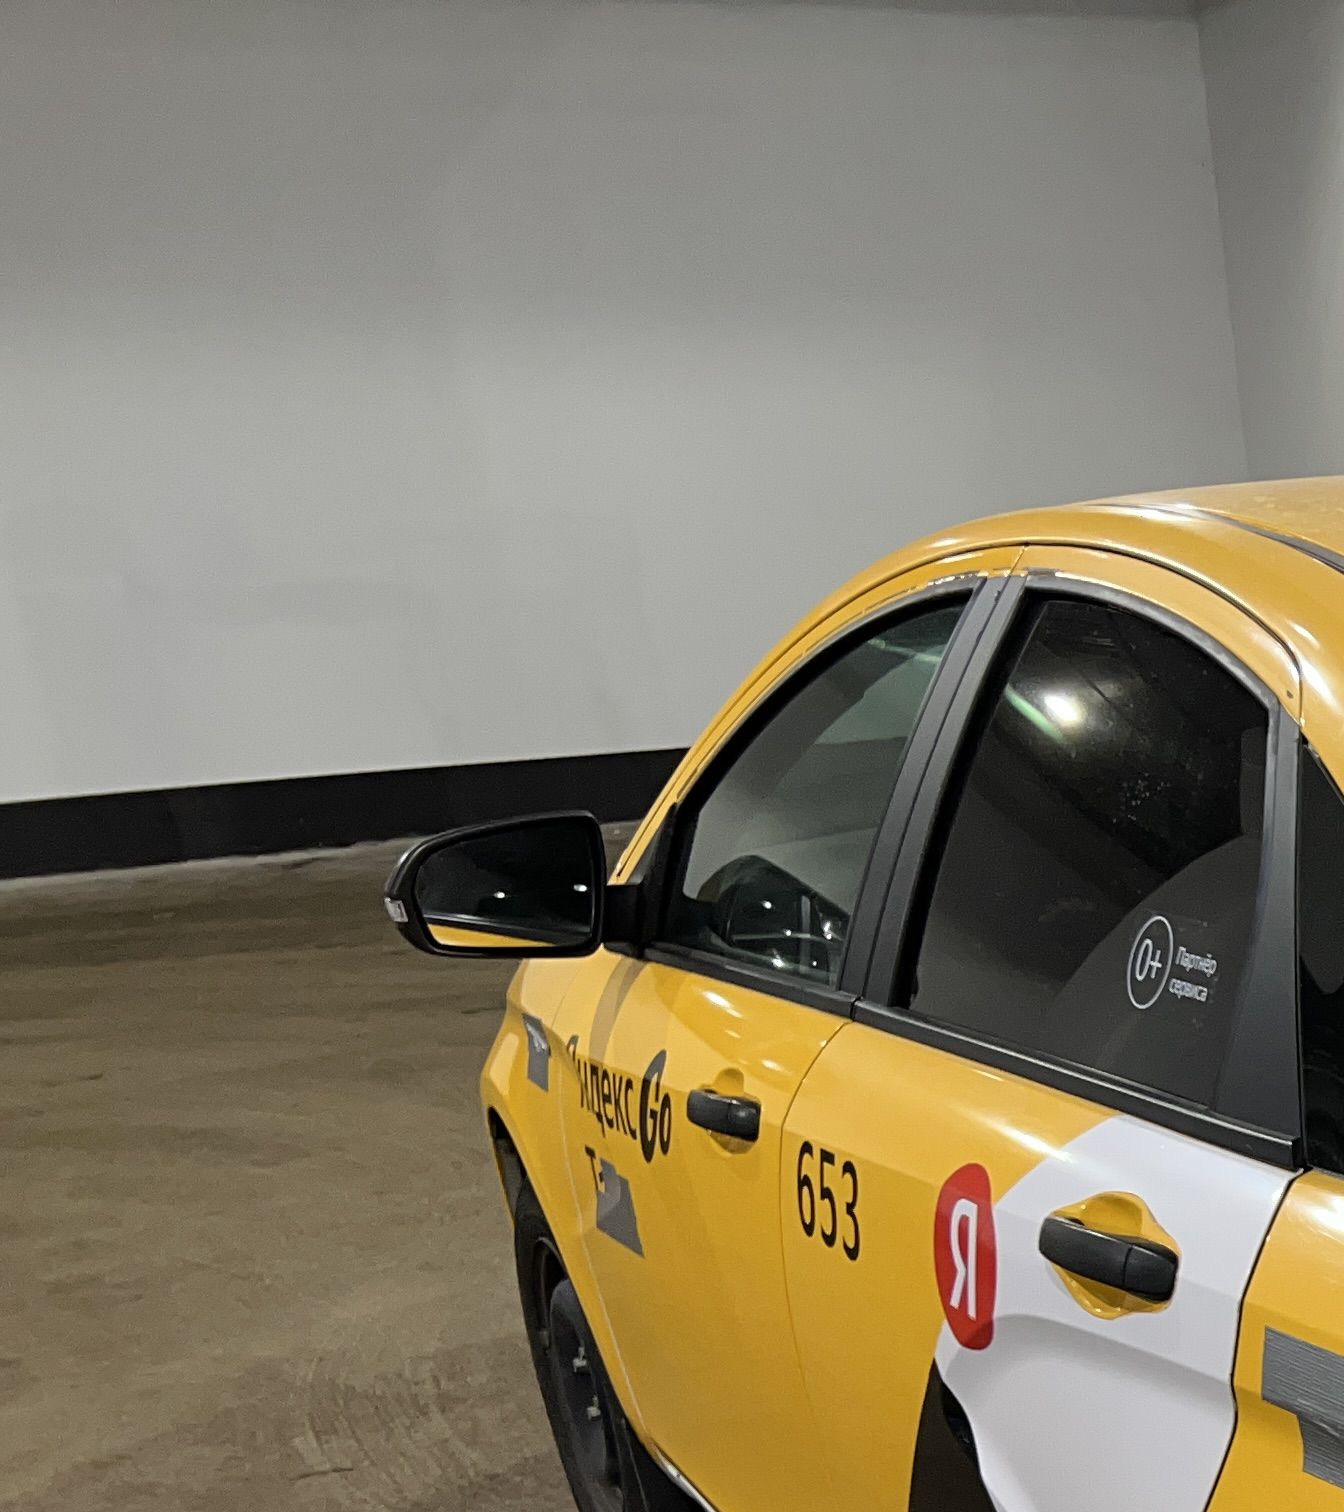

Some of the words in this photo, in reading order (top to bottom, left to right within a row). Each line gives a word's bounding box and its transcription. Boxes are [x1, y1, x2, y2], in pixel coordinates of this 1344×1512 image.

[1135, 938, 1162, 981] 0+
[639, 1048, 672, 1164] Go
[797, 1140, 861, 1262] 653
[948, 1196, 979, 1321] Я
